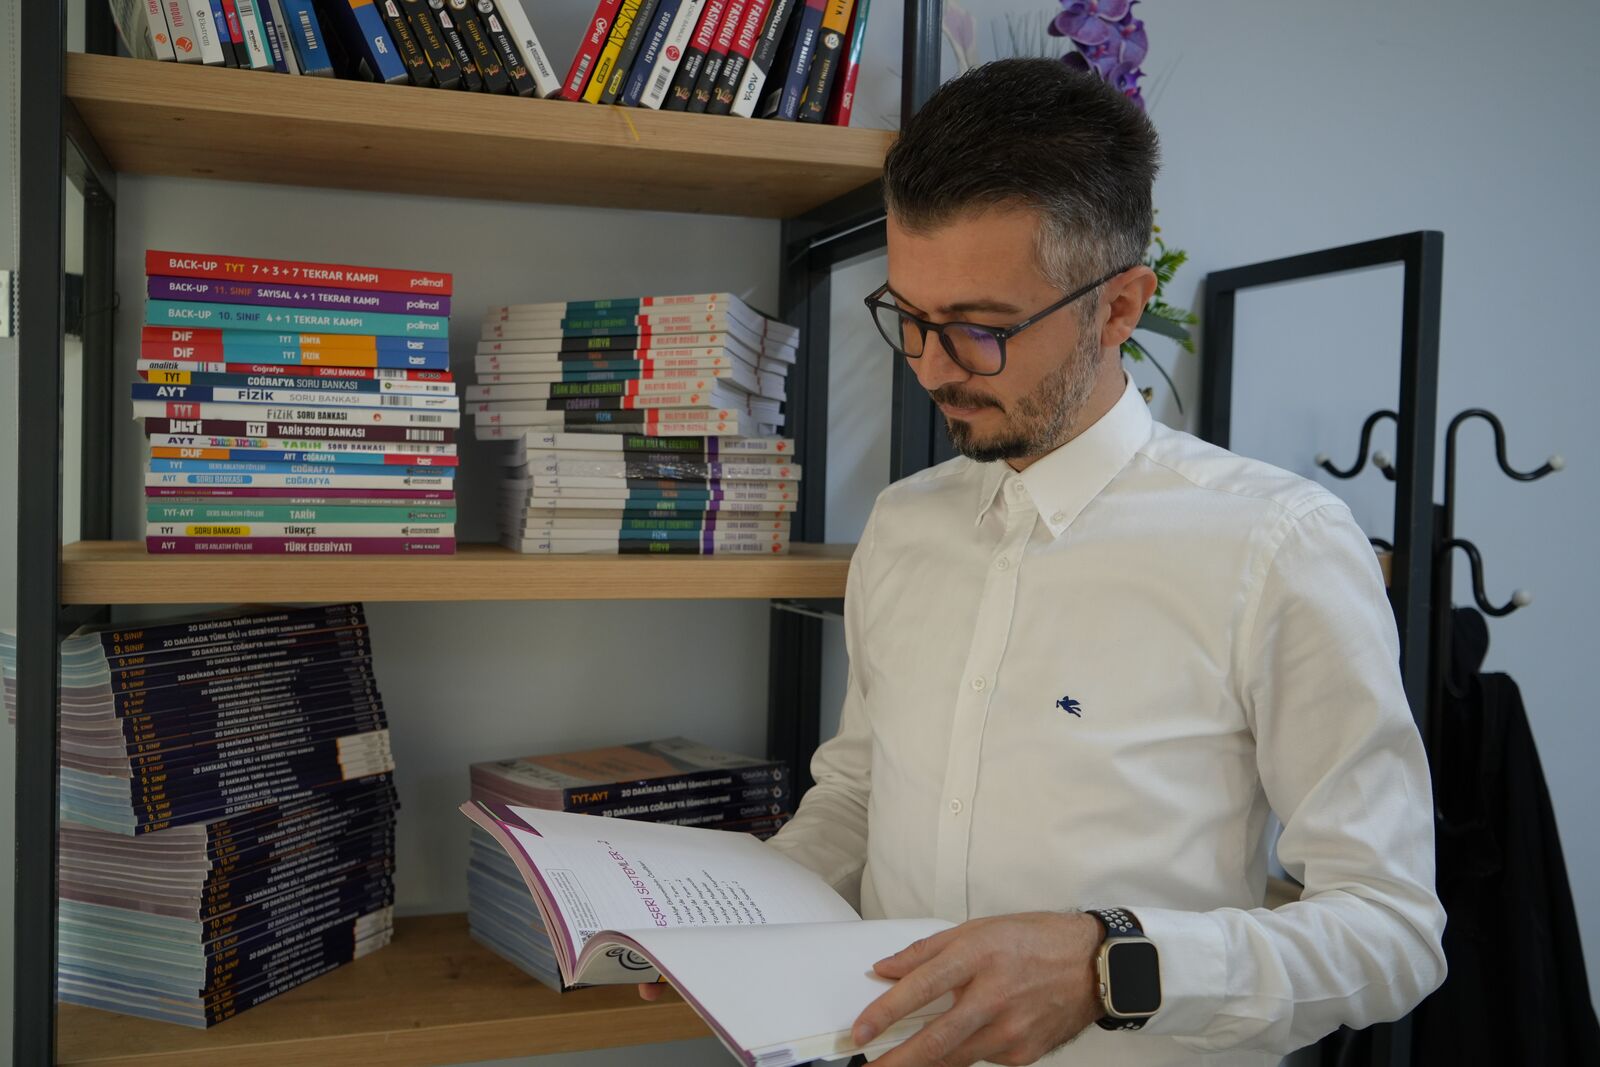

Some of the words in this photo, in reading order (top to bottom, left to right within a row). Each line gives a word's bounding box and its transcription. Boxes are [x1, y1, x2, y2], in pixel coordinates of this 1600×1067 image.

[658, 12, 671, 30] SORU
[698, 0, 722, 47] FASİKÜLÜ
[719, 2, 742, 46] FASİKÜLÜ
[738, 4, 762, 48] FASİKÜLÜ
[644, 31, 662, 64] BANKASI
[169, 258, 218, 271] BACK-UP
[225, 263, 245, 273] TYT
[252, 265, 258, 274] 7
[272, 266, 279, 275] 3
[292, 268, 299, 277] 7
[303, 269, 342, 281] TEKRAR
[346, 272, 378, 283] KAMPI
[410, 278, 443, 288] polimal
[169, 283, 208, 293] BACK-UP
[214, 286, 228, 294] 11.
[230, 288, 252, 296] SINIF
[257, 289, 291, 299] SAYISAL
[318, 293, 351, 303] TEKRAR
[353, 295, 379, 306] KAMPI
[407, 300, 439, 310] polimal
[168, 309, 211, 319] BACK-UP
[218, 312, 232, 320] 10.
[236, 313, 260, 321] SINIF
[266, 314, 273, 322] 4
[294, 315, 330, 325] TEKRAR
[334, 318, 362, 327] KAMPI
[407, 321, 439, 331] polimal
[150, 362, 179, 370] analitik
[252, 365, 284, 373] Coğrafya
[164, 372, 180, 382] TYT
[248, 377, 294, 387] COĞRAFYA
[296, 380, 319, 389] SORU
[322, 380, 358, 390] BANKASI
[156, 386, 187, 398] AYT
[238, 389, 274, 400] FİZİK
[319, 394, 360, 403] BANKASI
[173, 404, 192, 416] TYT
[267, 409, 293, 419] FİZİK
[296, 411, 316, 420] SORU
[318, 412, 347, 421] BANKASI
[249, 425, 264, 434] TYT
[278, 425, 302, 435] TARİH
[304, 427, 327, 436] SORU
[328, 428, 365, 438] BANKASI
[282, 441, 322, 450] TARİH
[302, 452, 336, 462] COĞRAFYA
[291, 465, 335, 473] COĞRAFYA
[215, 475, 243, 483] BANKASI
[286, 475, 330, 485] COĞRAFYA
[290, 510, 316, 519] TARİH
[194, 527, 211, 535] SORU
[213, 527, 241, 535] BANKASI
[284, 526, 316, 536] TÜRKÇE
[285, 543, 307, 552] TÜRK
[309, 542, 352, 552] EDEBİYATI
[123, 631, 144, 640] SINIF
[124, 643, 144, 652] SINIF
[174, 634, 208, 646] DAKİKADA
[210, 632, 226, 641] TÜRK
[571, 790, 608, 805] TYT-AYT
[621, 788, 630, 797] 20
[632, 783, 666, 796] DAKİKADA
[613, 803, 648, 816] DAKİKADA
[650, 798, 684, 812] COĞRAFYA
[608, 850, 650, 895] SİSTEMLER
[640, 898, 667, 926] EŞERİ
